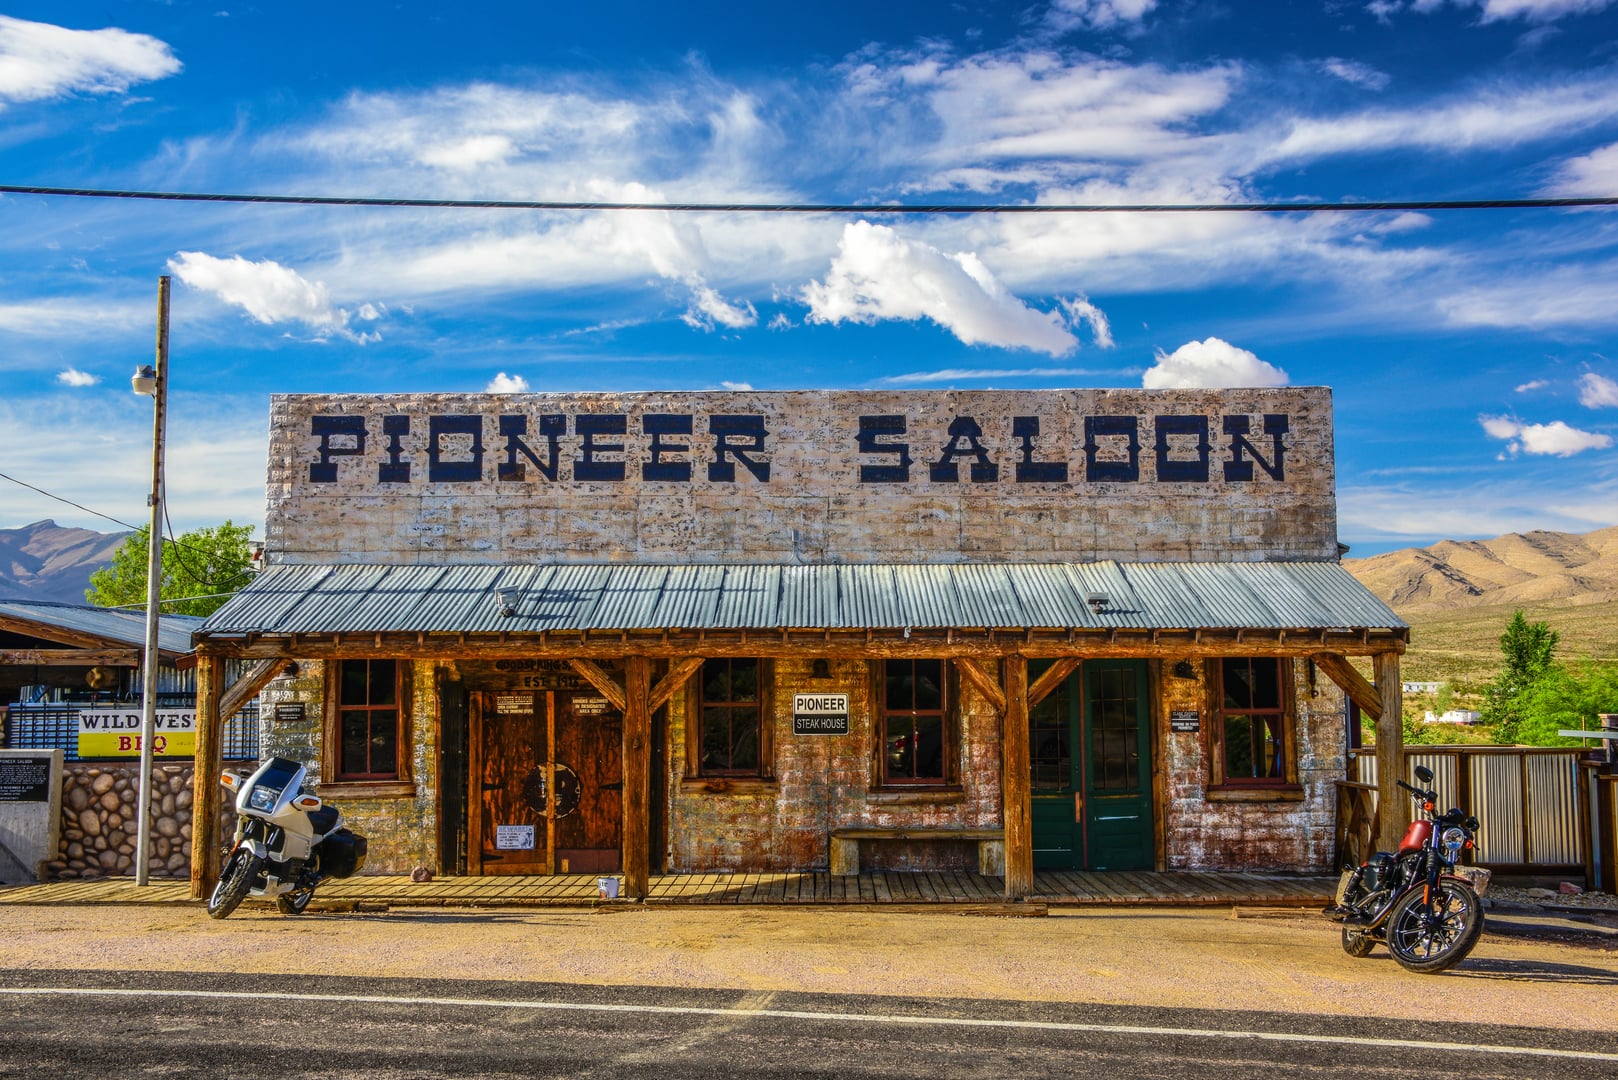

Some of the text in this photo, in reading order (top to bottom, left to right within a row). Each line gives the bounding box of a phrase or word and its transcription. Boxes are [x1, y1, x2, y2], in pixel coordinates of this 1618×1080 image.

[309, 414, 1290, 483] PIONEER SALOON
[797, 698, 845, 710] PIONEER
[81, 714, 197, 729] WILD WES
[796, 718, 846, 728] STEAK HOUSE
